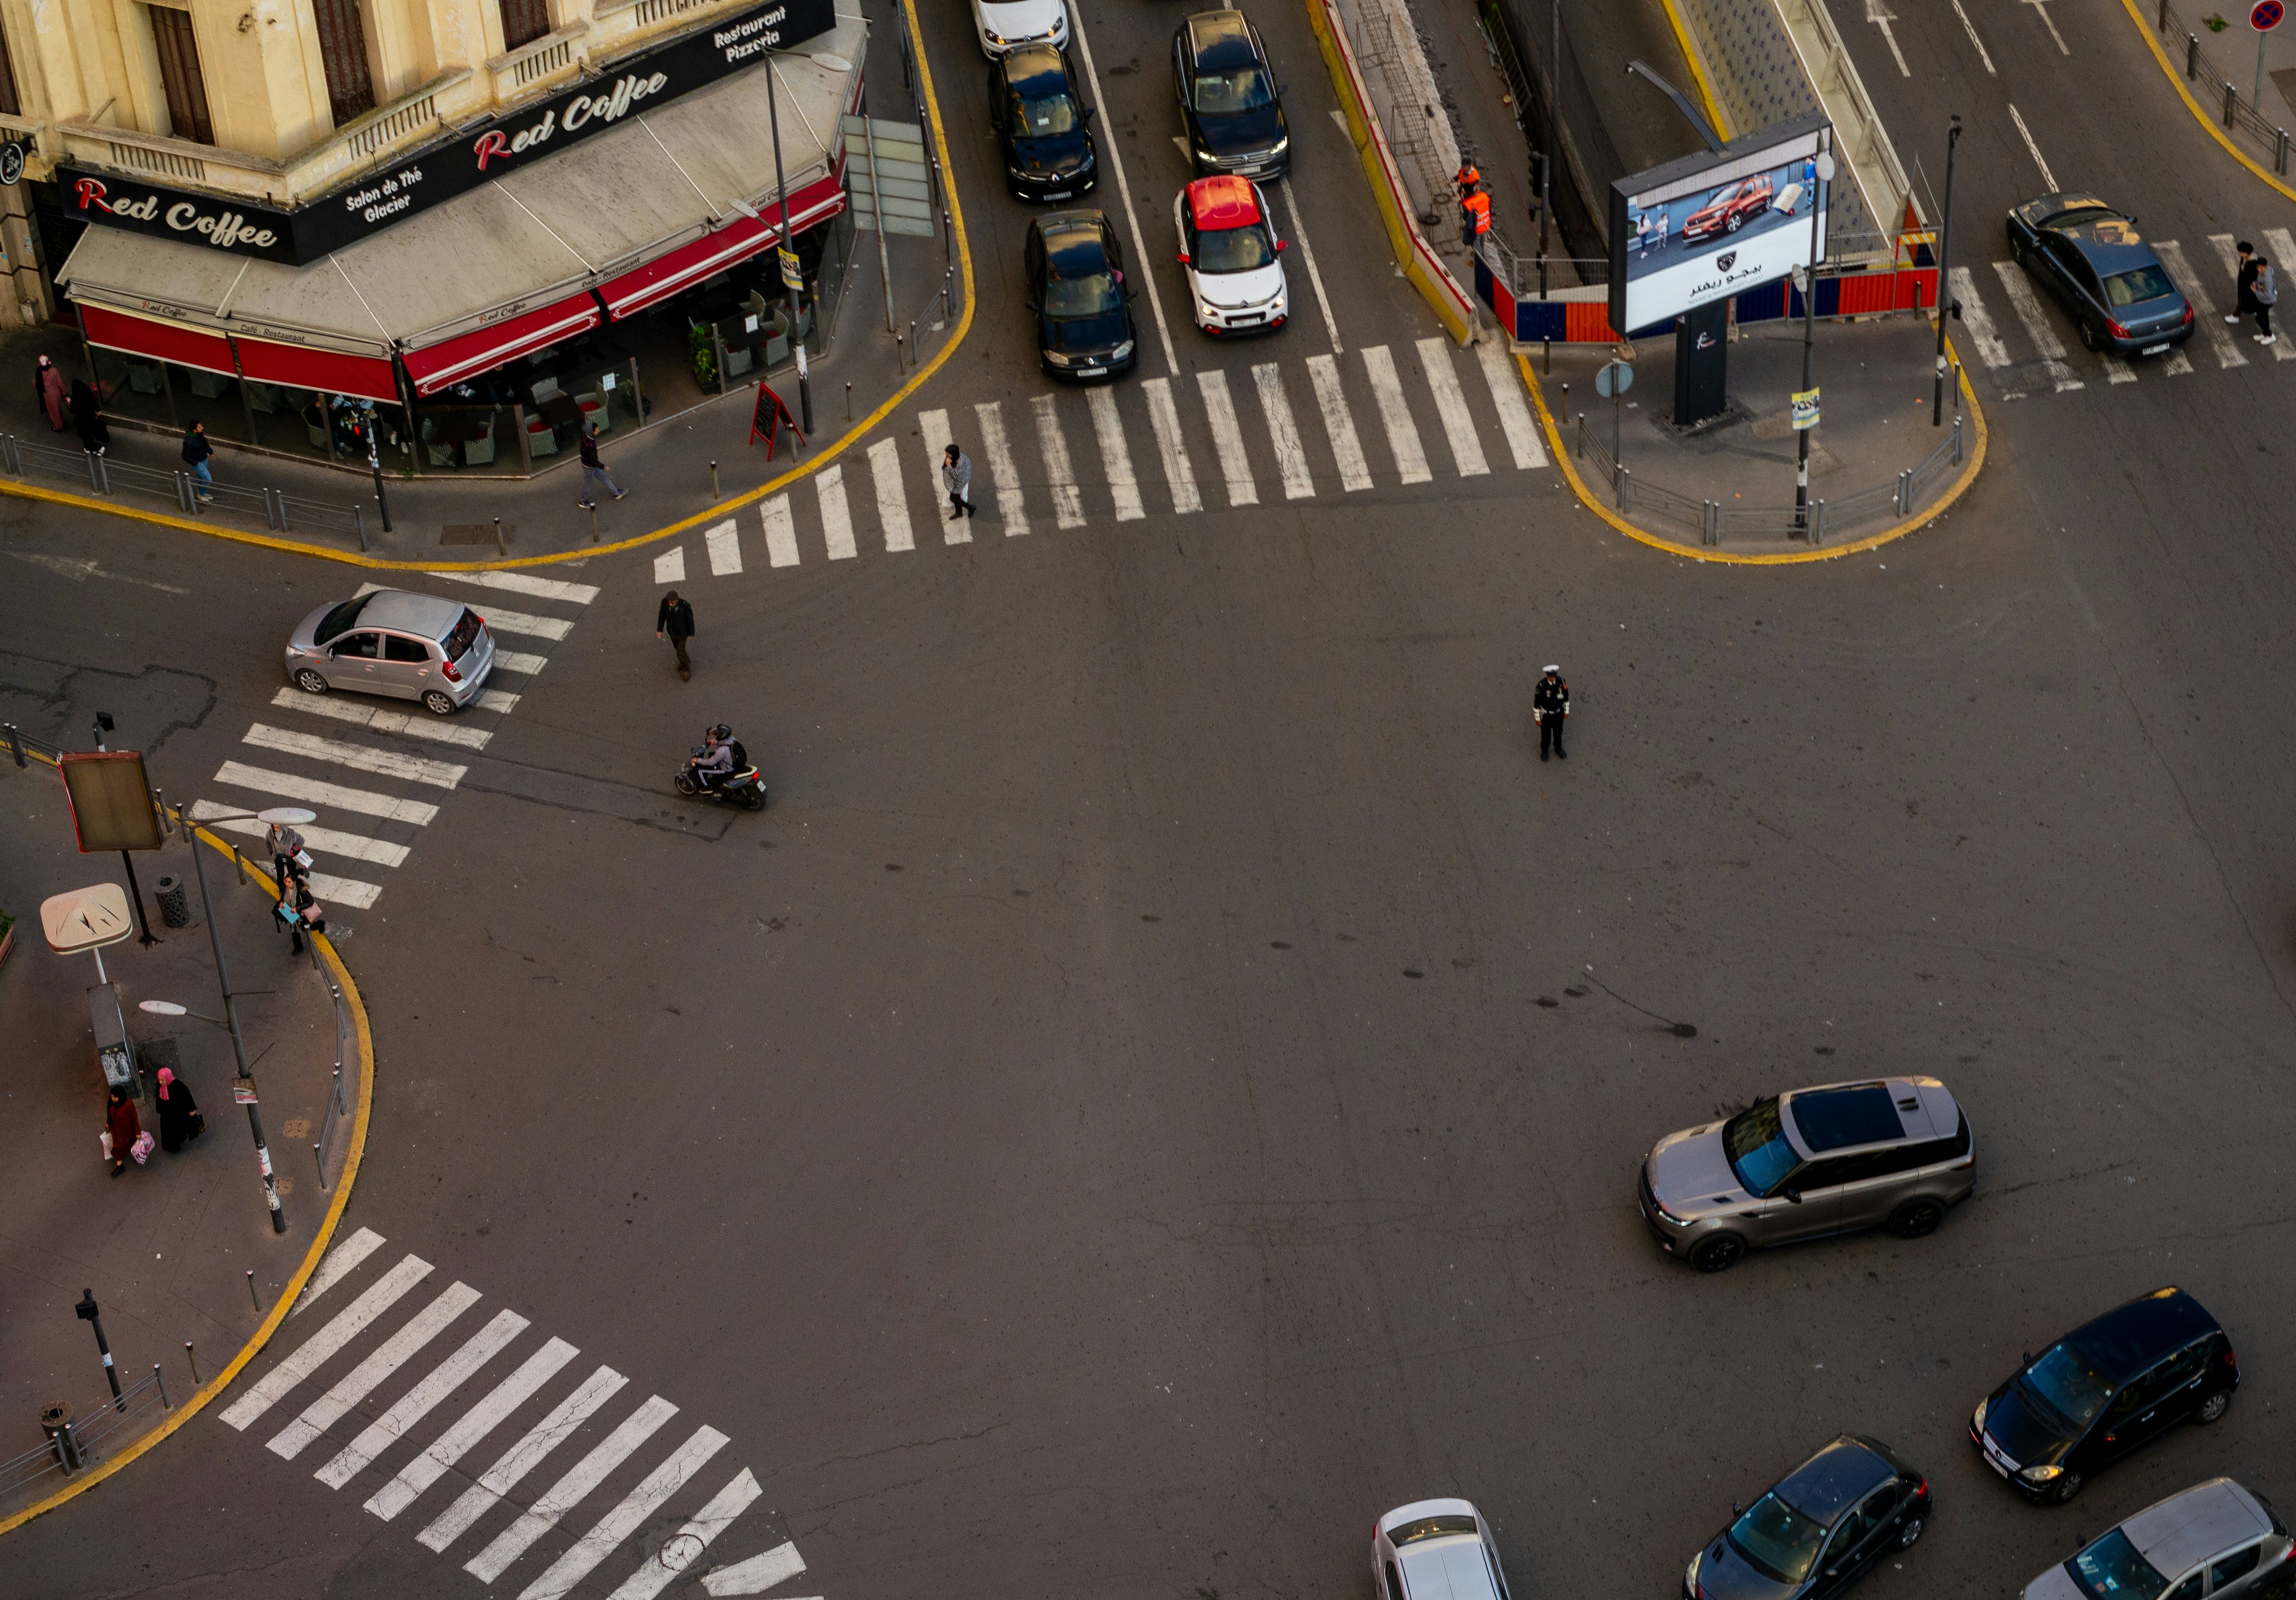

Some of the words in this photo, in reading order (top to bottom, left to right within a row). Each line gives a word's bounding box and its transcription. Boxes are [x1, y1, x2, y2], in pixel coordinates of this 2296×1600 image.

[714, 5, 786, 48] Restaurant
[725, 31, 779, 63] Pizzeria
[474, 110, 555, 171] Red
[562, 72, 668, 131] Coffee
[346, 190, 381, 211] Salon
[382, 179, 399, 195] de
[398, 165, 423, 187] Thé
[75, 177, 158, 221] Red
[165, 202, 277, 247] Coffee
[364, 194, 411, 223] Glacier
[142, 300, 161, 311] Red
[162, 306, 188, 317] Coffee
[478, 311, 499, 324] Red
[240, 324, 257, 333] Café
[263, 328, 305, 343] Restaurant
